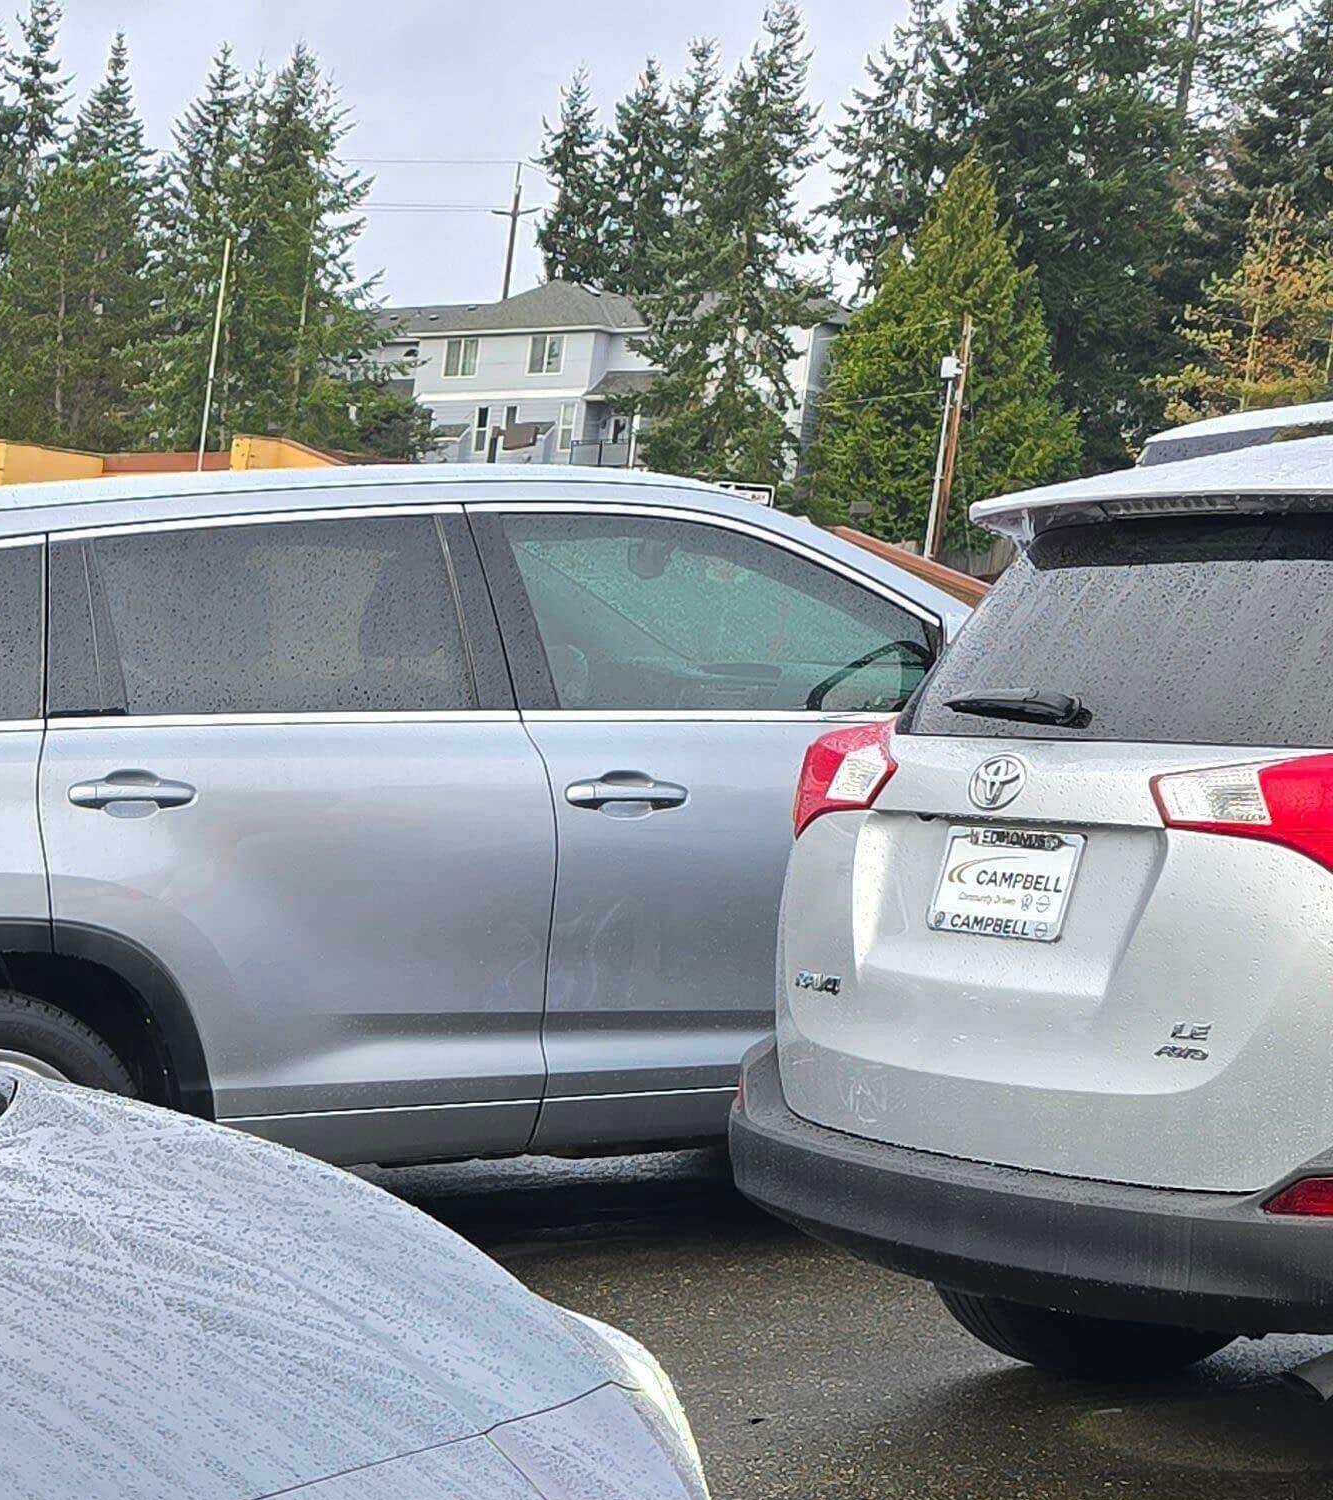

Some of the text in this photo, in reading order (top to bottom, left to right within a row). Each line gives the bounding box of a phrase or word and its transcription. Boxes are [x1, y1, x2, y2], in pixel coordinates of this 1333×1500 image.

[976, 870, 1062, 893] CAMPBELL
[950, 914, 1029, 936] CAMPBELL
[1171, 1022, 1211, 1040] LE
